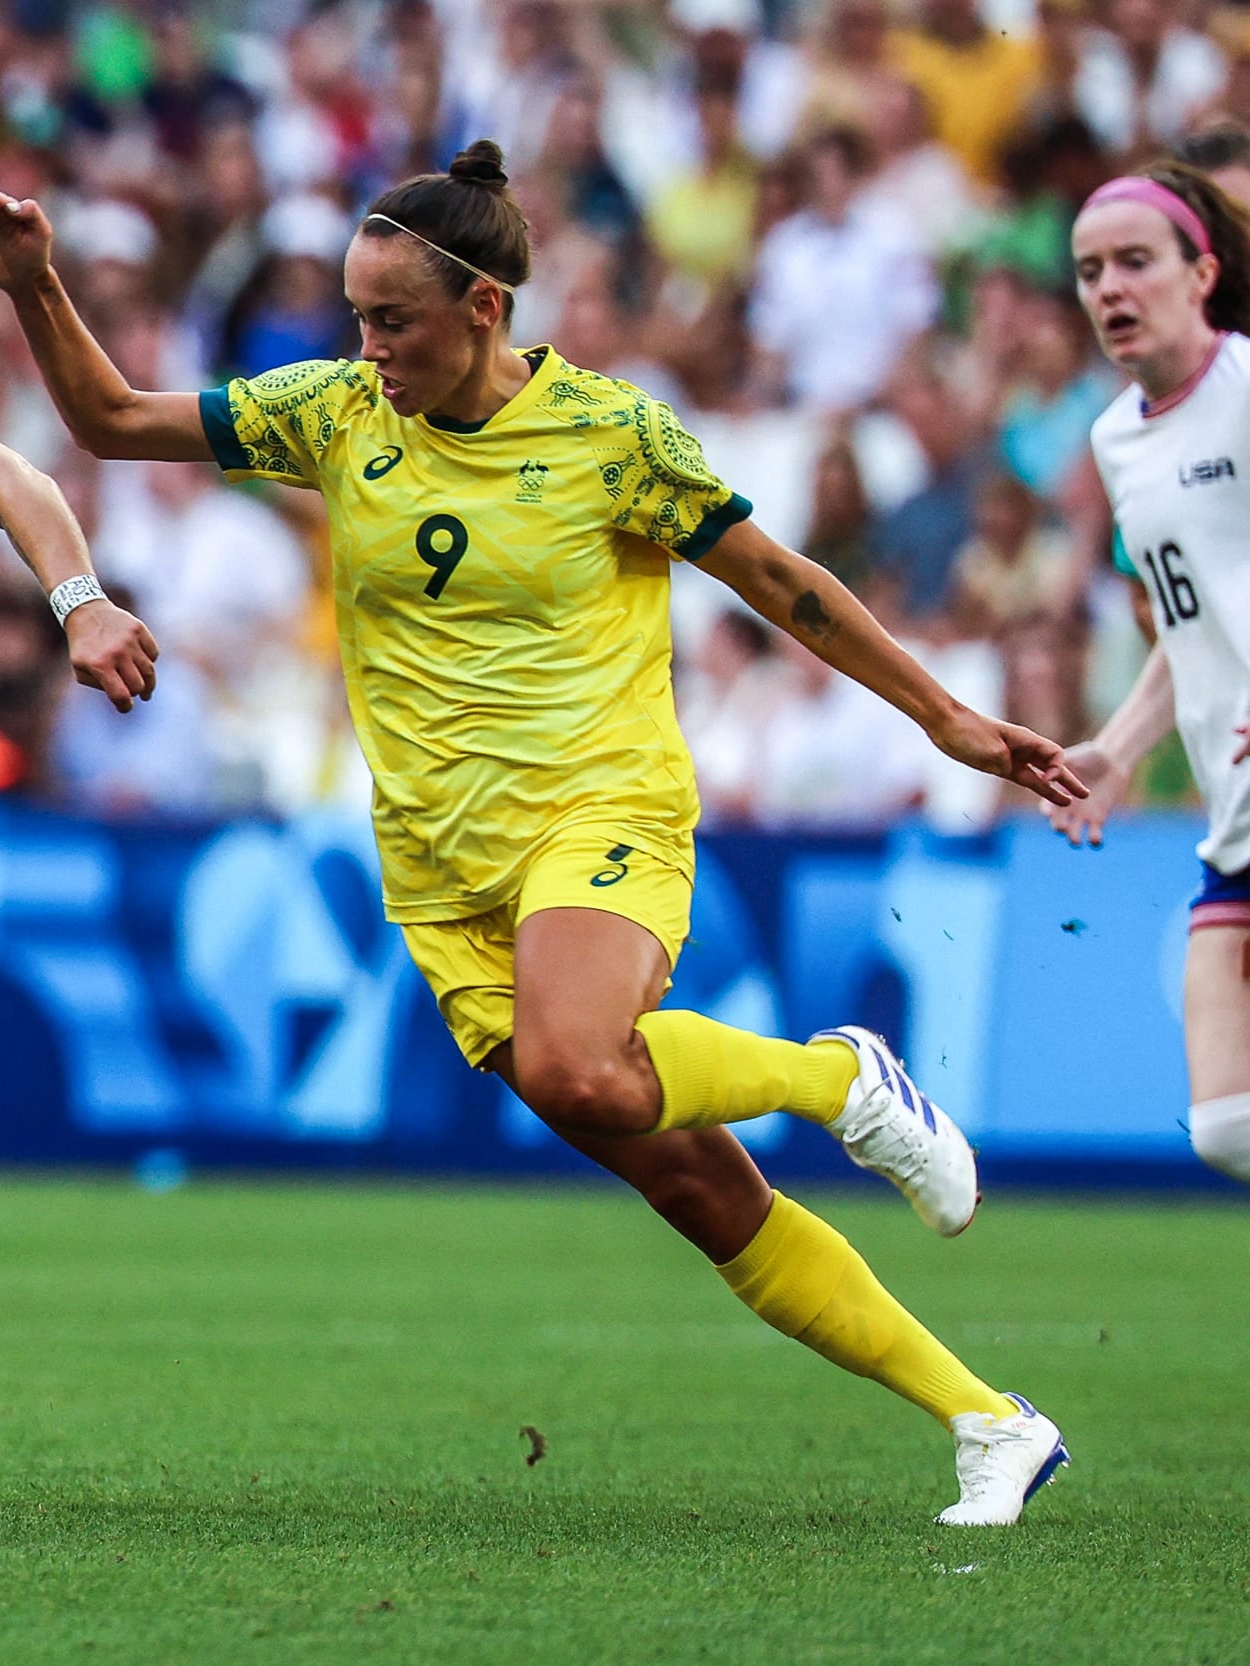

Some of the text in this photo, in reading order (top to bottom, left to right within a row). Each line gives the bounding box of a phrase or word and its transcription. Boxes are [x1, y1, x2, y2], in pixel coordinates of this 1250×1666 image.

[1179, 456, 1236, 487] USA
[415, 513, 469, 601] 9
[1144, 541, 1200, 627] 16
